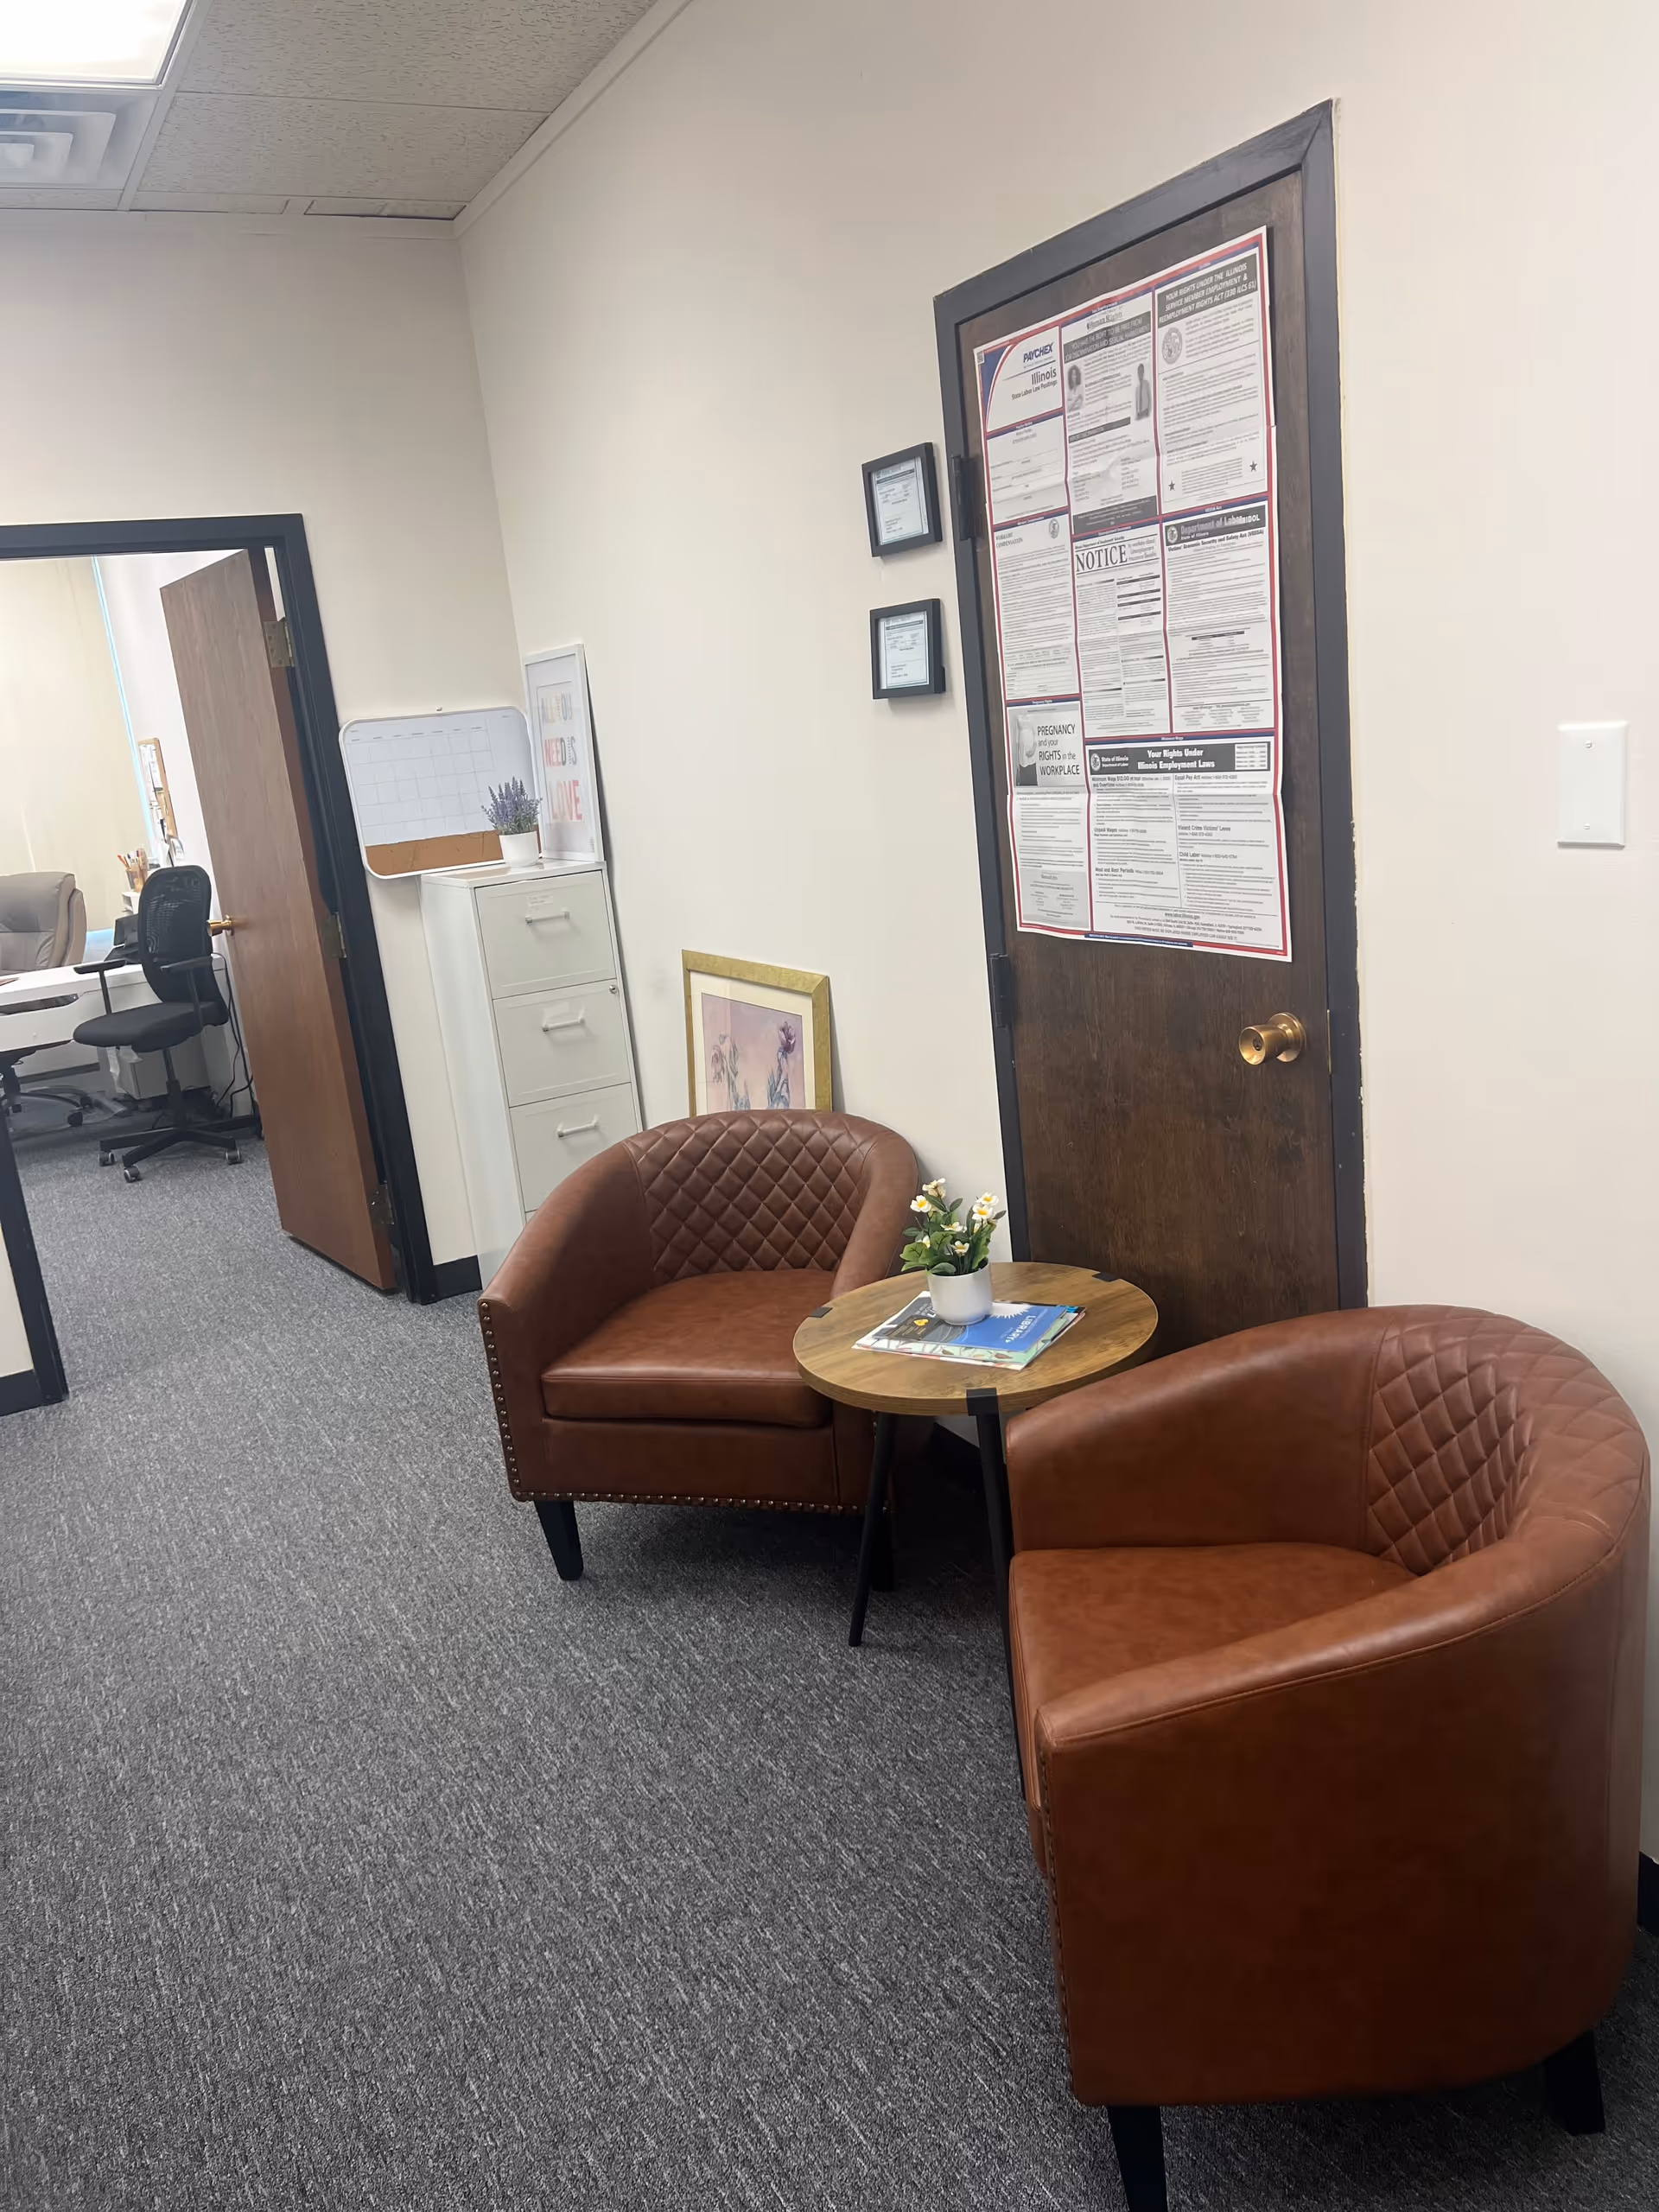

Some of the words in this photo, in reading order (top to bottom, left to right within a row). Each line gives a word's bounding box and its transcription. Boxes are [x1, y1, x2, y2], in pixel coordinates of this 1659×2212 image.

[1166, 291, 1178, 301] YOUR
[1179, 283, 1195, 295] RIGHTS
[1197, 276, 1213, 289] UNDER
[1214, 272, 1224, 281] THE
[1226, 263, 1247, 276] ILLINOIS
[1166, 300, 1183, 311] SERVICE
[1185, 292, 1205, 304] MEMBER
[1205, 276, 1241, 296] EMPLOYMENT
[1159, 304, 1195, 323] REEMPLOYMENT
[1196, 298, 1213, 309] RIGHTS
[1214, 293, 1224, 302] ACT
[1023, 342, 1054, 363] PAYCHEX
[1031, 366, 1057, 385] Illinois
[1021, 388, 1033, 397] Labor
[1040, 379, 1058, 389] Postings
[1181, 522, 1214, 535] Department
[1216, 518, 1223, 526] of
[1075, 544, 1127, 572] NOTICE
[1037, 724, 1075, 735] PREGNANCY
[544, 737, 567, 768] NEED
[1039, 750, 1061, 760] RIGHTS
[1163, 749, 1183, 759] Rights
[1185, 748, 1204, 757] Under
[1039, 765, 1080, 775] WORKPLACE
[1159, 760, 1197, 771] Employment
[1198, 760, 1215, 768] Laws
[548, 779, 583, 821] LOVE
[1006, 1315, 1036, 1343] LIBRARY
